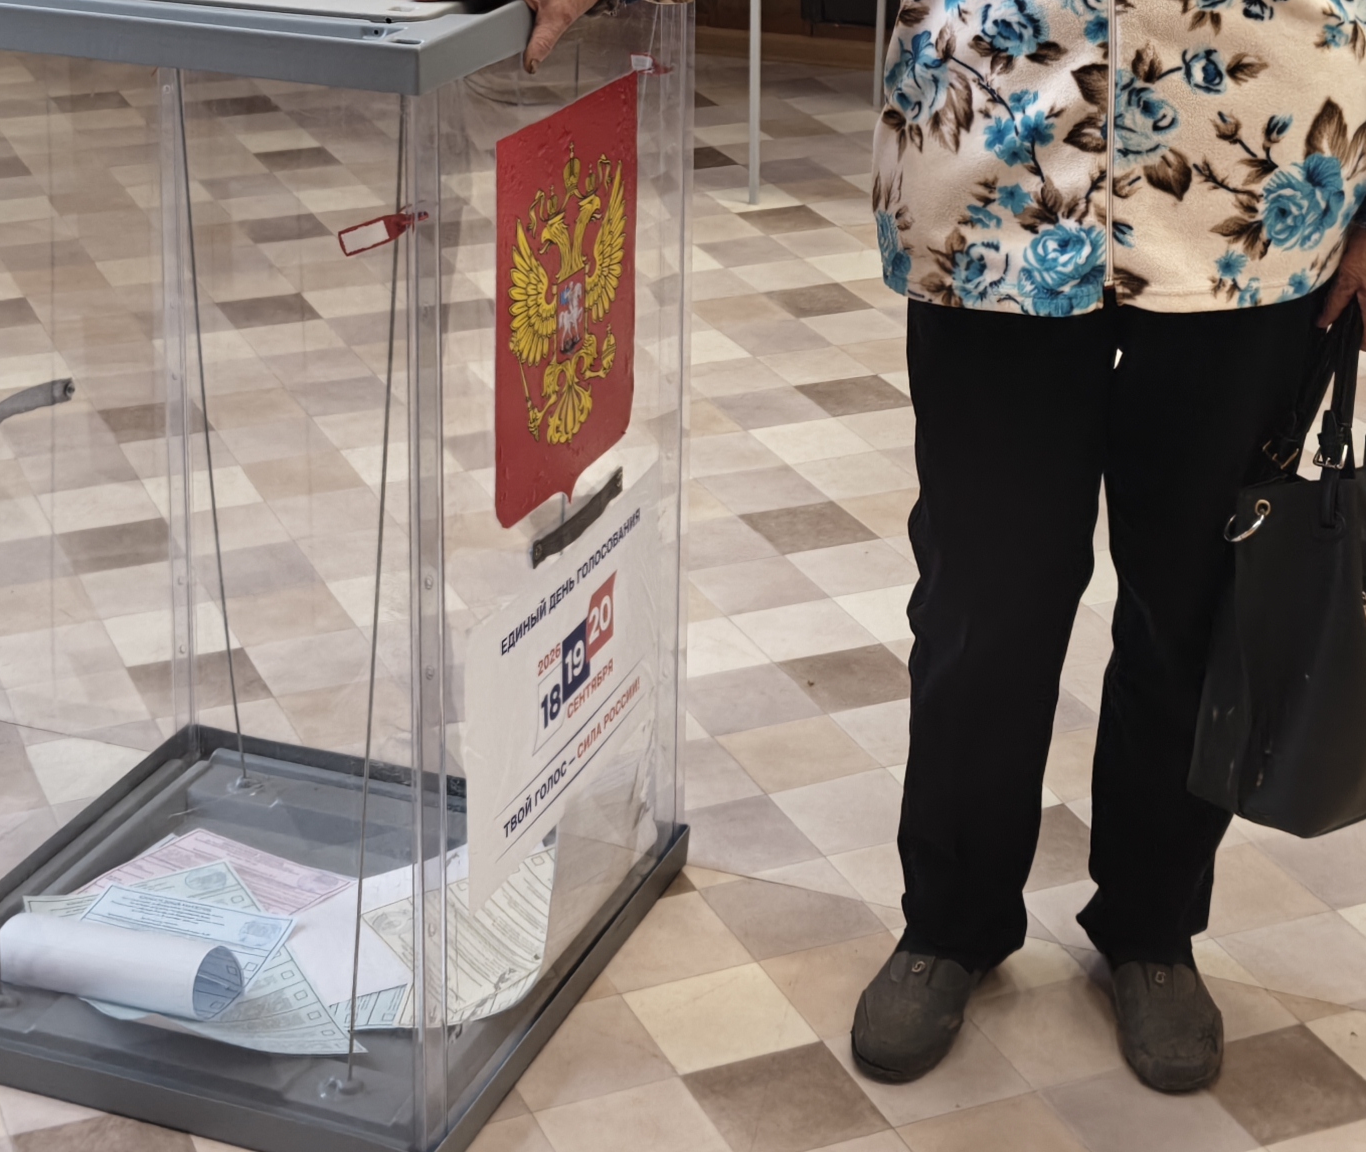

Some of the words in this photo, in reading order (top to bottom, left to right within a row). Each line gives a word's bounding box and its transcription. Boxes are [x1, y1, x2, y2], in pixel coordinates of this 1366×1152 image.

[501, 597, 547, 656] ЕДИНЫЙ
[548, 576, 575, 614] ДЕНЬ
[577, 507, 640, 584] ГОЛОСОВАНИЯ
[537, 642, 561, 677] 2026
[541, 683, 561, 730] 18
[565, 640, 585, 683] 19
[588, 595, 611, 645] 20
[567, 658, 613, 719] СЕНТЯБРЯ
[503, 794, 532, 838] ТВОЙ
[535, 760, 567, 807] ГОЛОС
[577, 723, 602, 759] СИЛА
[604, 676, 641, 730] РОССИИ!
